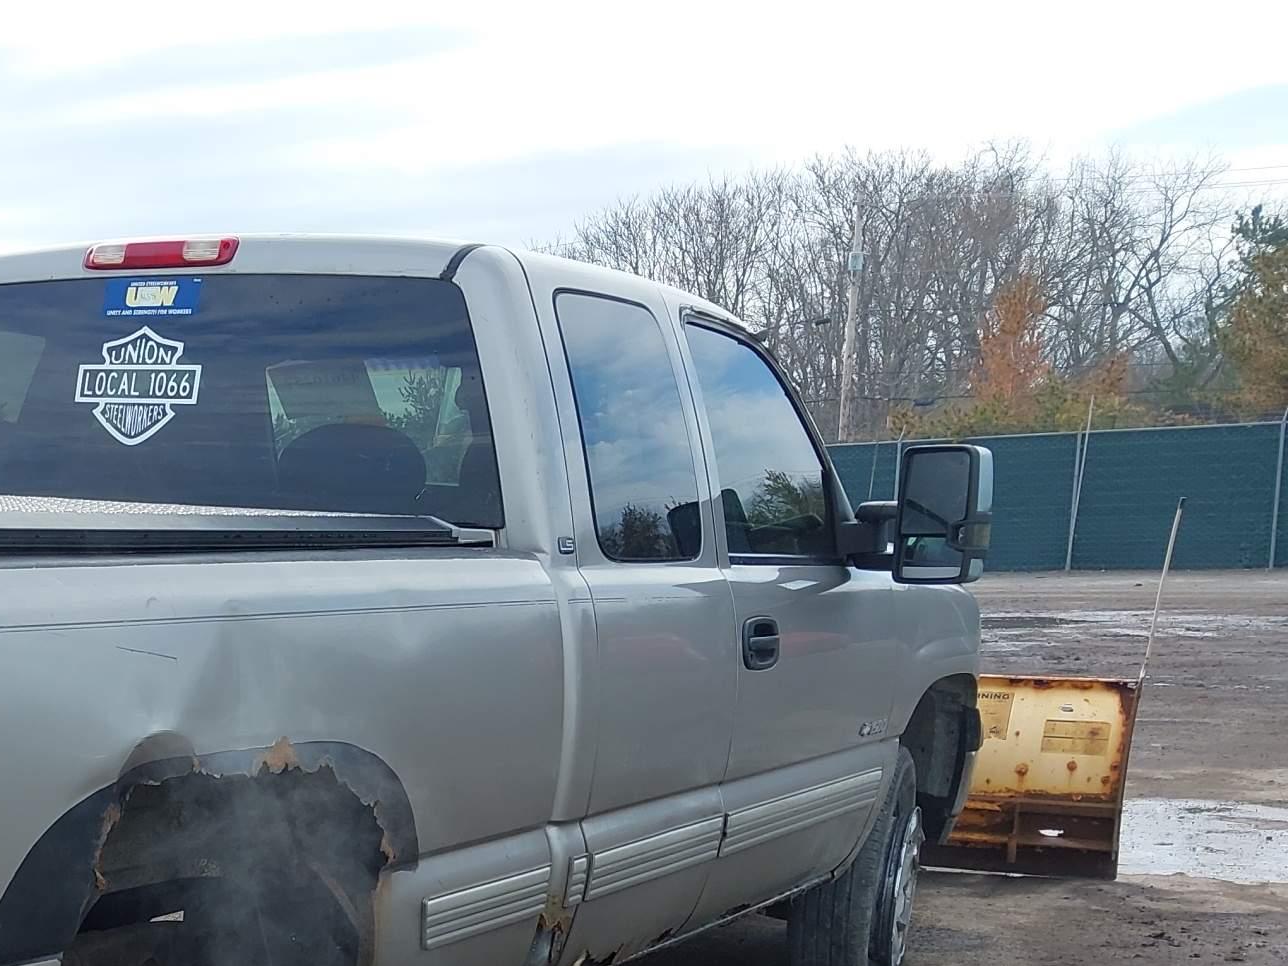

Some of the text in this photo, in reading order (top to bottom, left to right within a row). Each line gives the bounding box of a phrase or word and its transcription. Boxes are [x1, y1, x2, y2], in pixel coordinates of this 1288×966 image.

[111, 338, 172, 364] UNION
[83, 371, 191, 397] LOCAL 1066
[104, 403, 164, 436] STEELWORKERS
